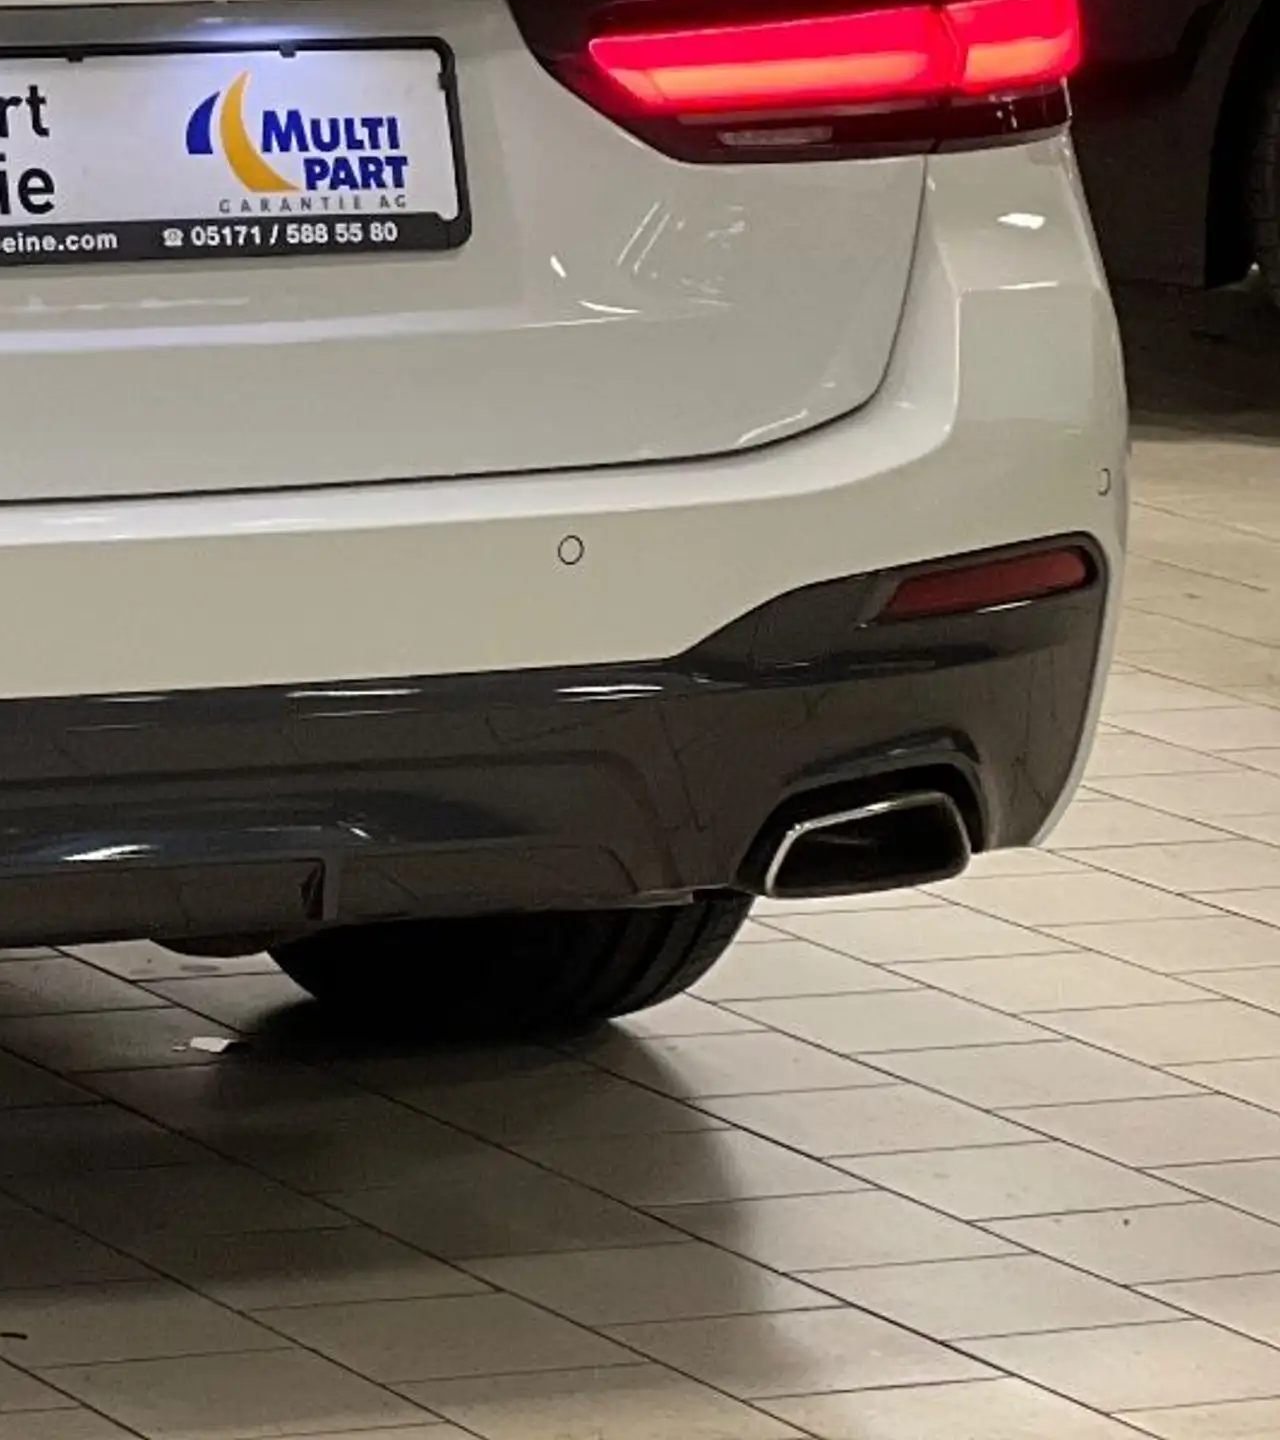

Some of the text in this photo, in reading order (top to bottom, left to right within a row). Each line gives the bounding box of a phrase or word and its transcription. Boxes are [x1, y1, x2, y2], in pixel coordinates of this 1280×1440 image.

[261, 109, 401, 153] MULTI
[303, 155, 408, 191] PART
[218, 194, 407, 215] GARANTIE AG
[190, 226, 262, 246] 05171
[286, 223, 329, 244] 588
[335, 222, 363, 243] 55
[369, 221, 399, 242] 80
